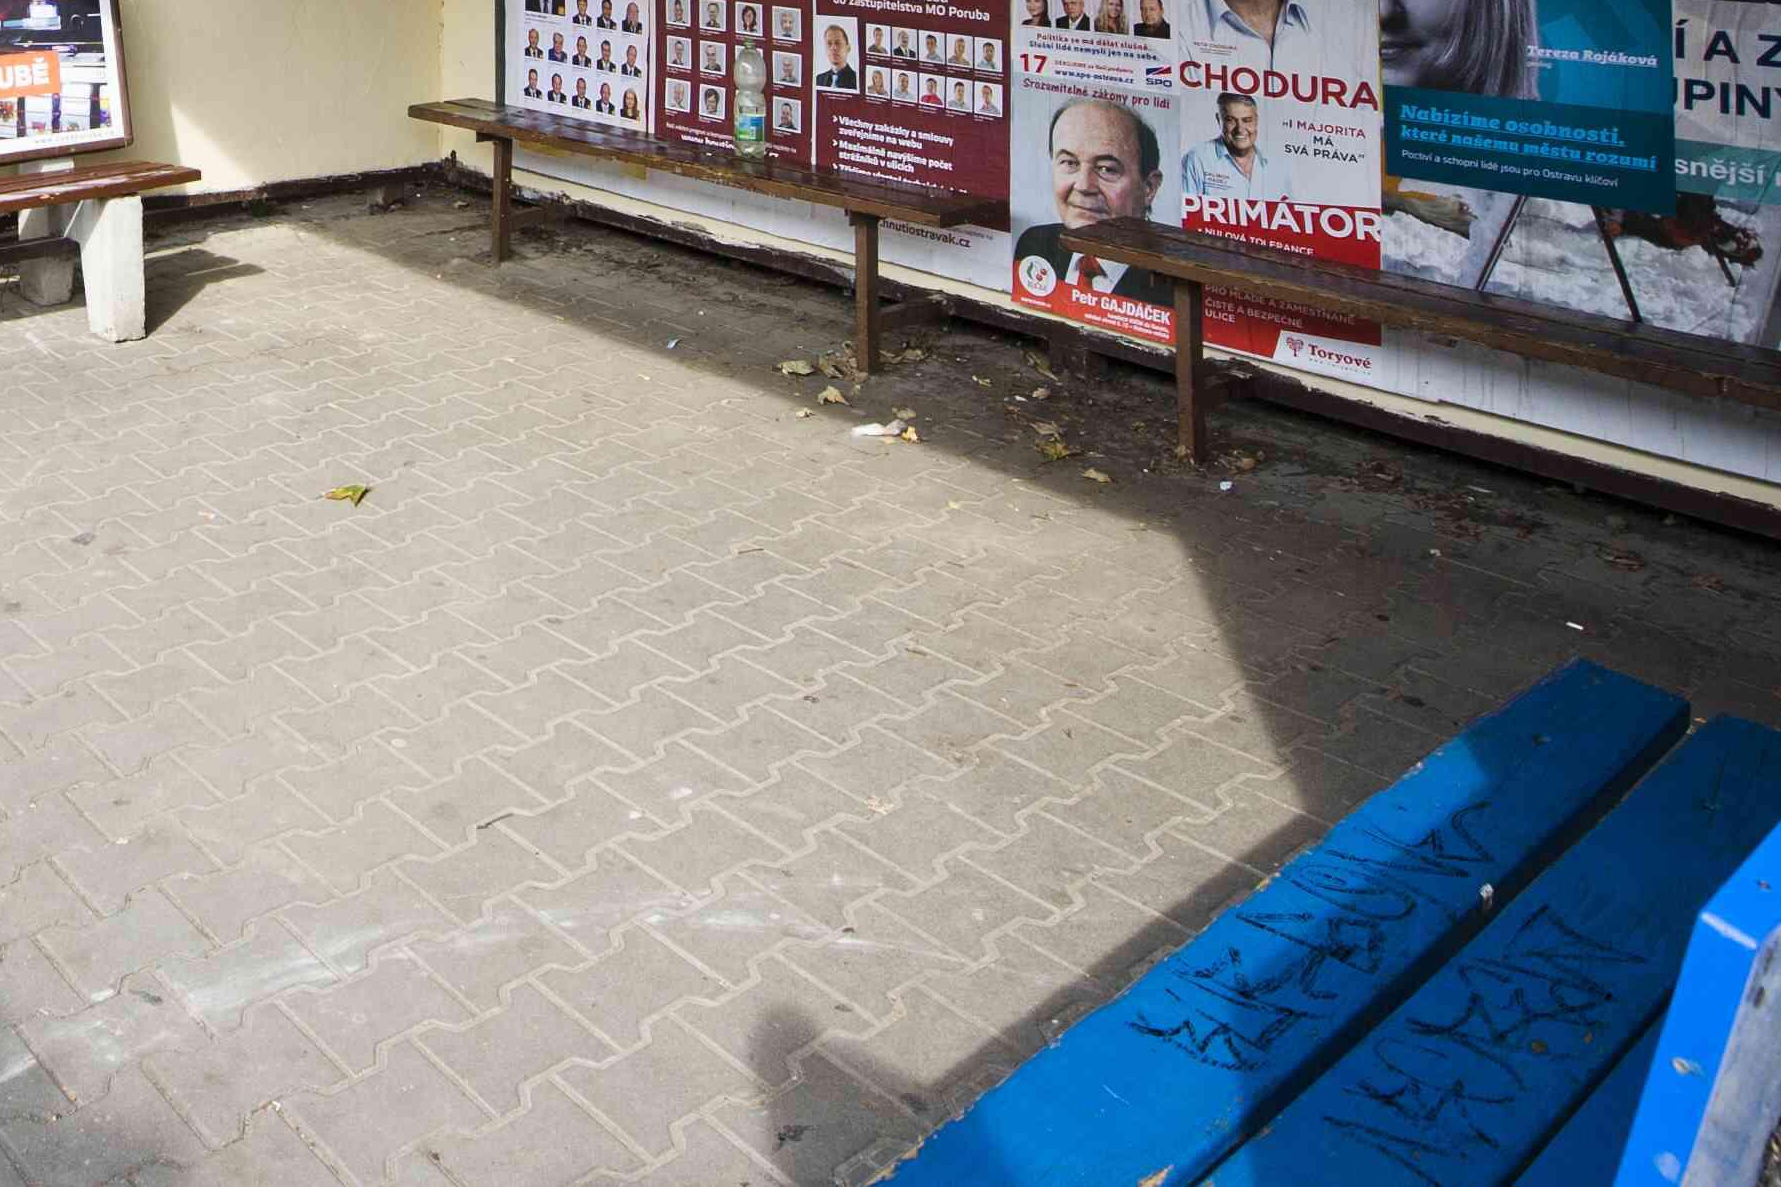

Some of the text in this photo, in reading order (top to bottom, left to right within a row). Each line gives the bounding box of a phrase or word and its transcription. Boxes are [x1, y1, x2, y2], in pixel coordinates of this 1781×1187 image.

[925, 4, 946, 16] MO
[949, 7, 990, 22] Poruba
[1036, 32, 1069, 42] Politika
[1074, 45, 1106, 57] nemyslí
[1108, 49, 1122, 58] jen
[1527, 44, 1658, 68] Tereza Rojáková
[1020, 53, 1048, 74] 17
[1023, 77, 1088, 97] Srozumitelné
[1092, 88, 1127, 106] zákony
[1132, 94, 1150, 107] pro
[1146, 77, 1173, 88] SPO
[1179, 60, 1379, 111] CHODURA
[839, 116, 873, 131] Všechny
[1400, 104, 1502, 130] Nabízíme
[1297, 120, 1366, 139] MAJORITA
[886, 136, 897, 145] na
[898, 137, 923, 150] webu
[1284, 143, 1309, 156] SVÁ
[1313, 134, 1334, 147] MÁ
[1399, 125, 1658, 172] které našemu městu rozumí
[928, 157, 953, 171] počet
[1401, 149, 1432, 163] Poctiví
[1443, 155, 1480, 170] schopní
[1500, 162, 1522, 175] jsou
[1523, 167, 1541, 179] pro
[1542, 168, 1583, 183] Ostravu
[1181, 194, 1381, 243] PRIMÁTOR
[1071, 288, 1098, 307] Petr
[1100, 295, 1171, 326] GAJDÁČEK
[1204, 309, 1237, 324] ULICE
[1247, 307, 1304, 329] BEZPEČNÉ
[1308, 343, 1372, 369] Toryové
